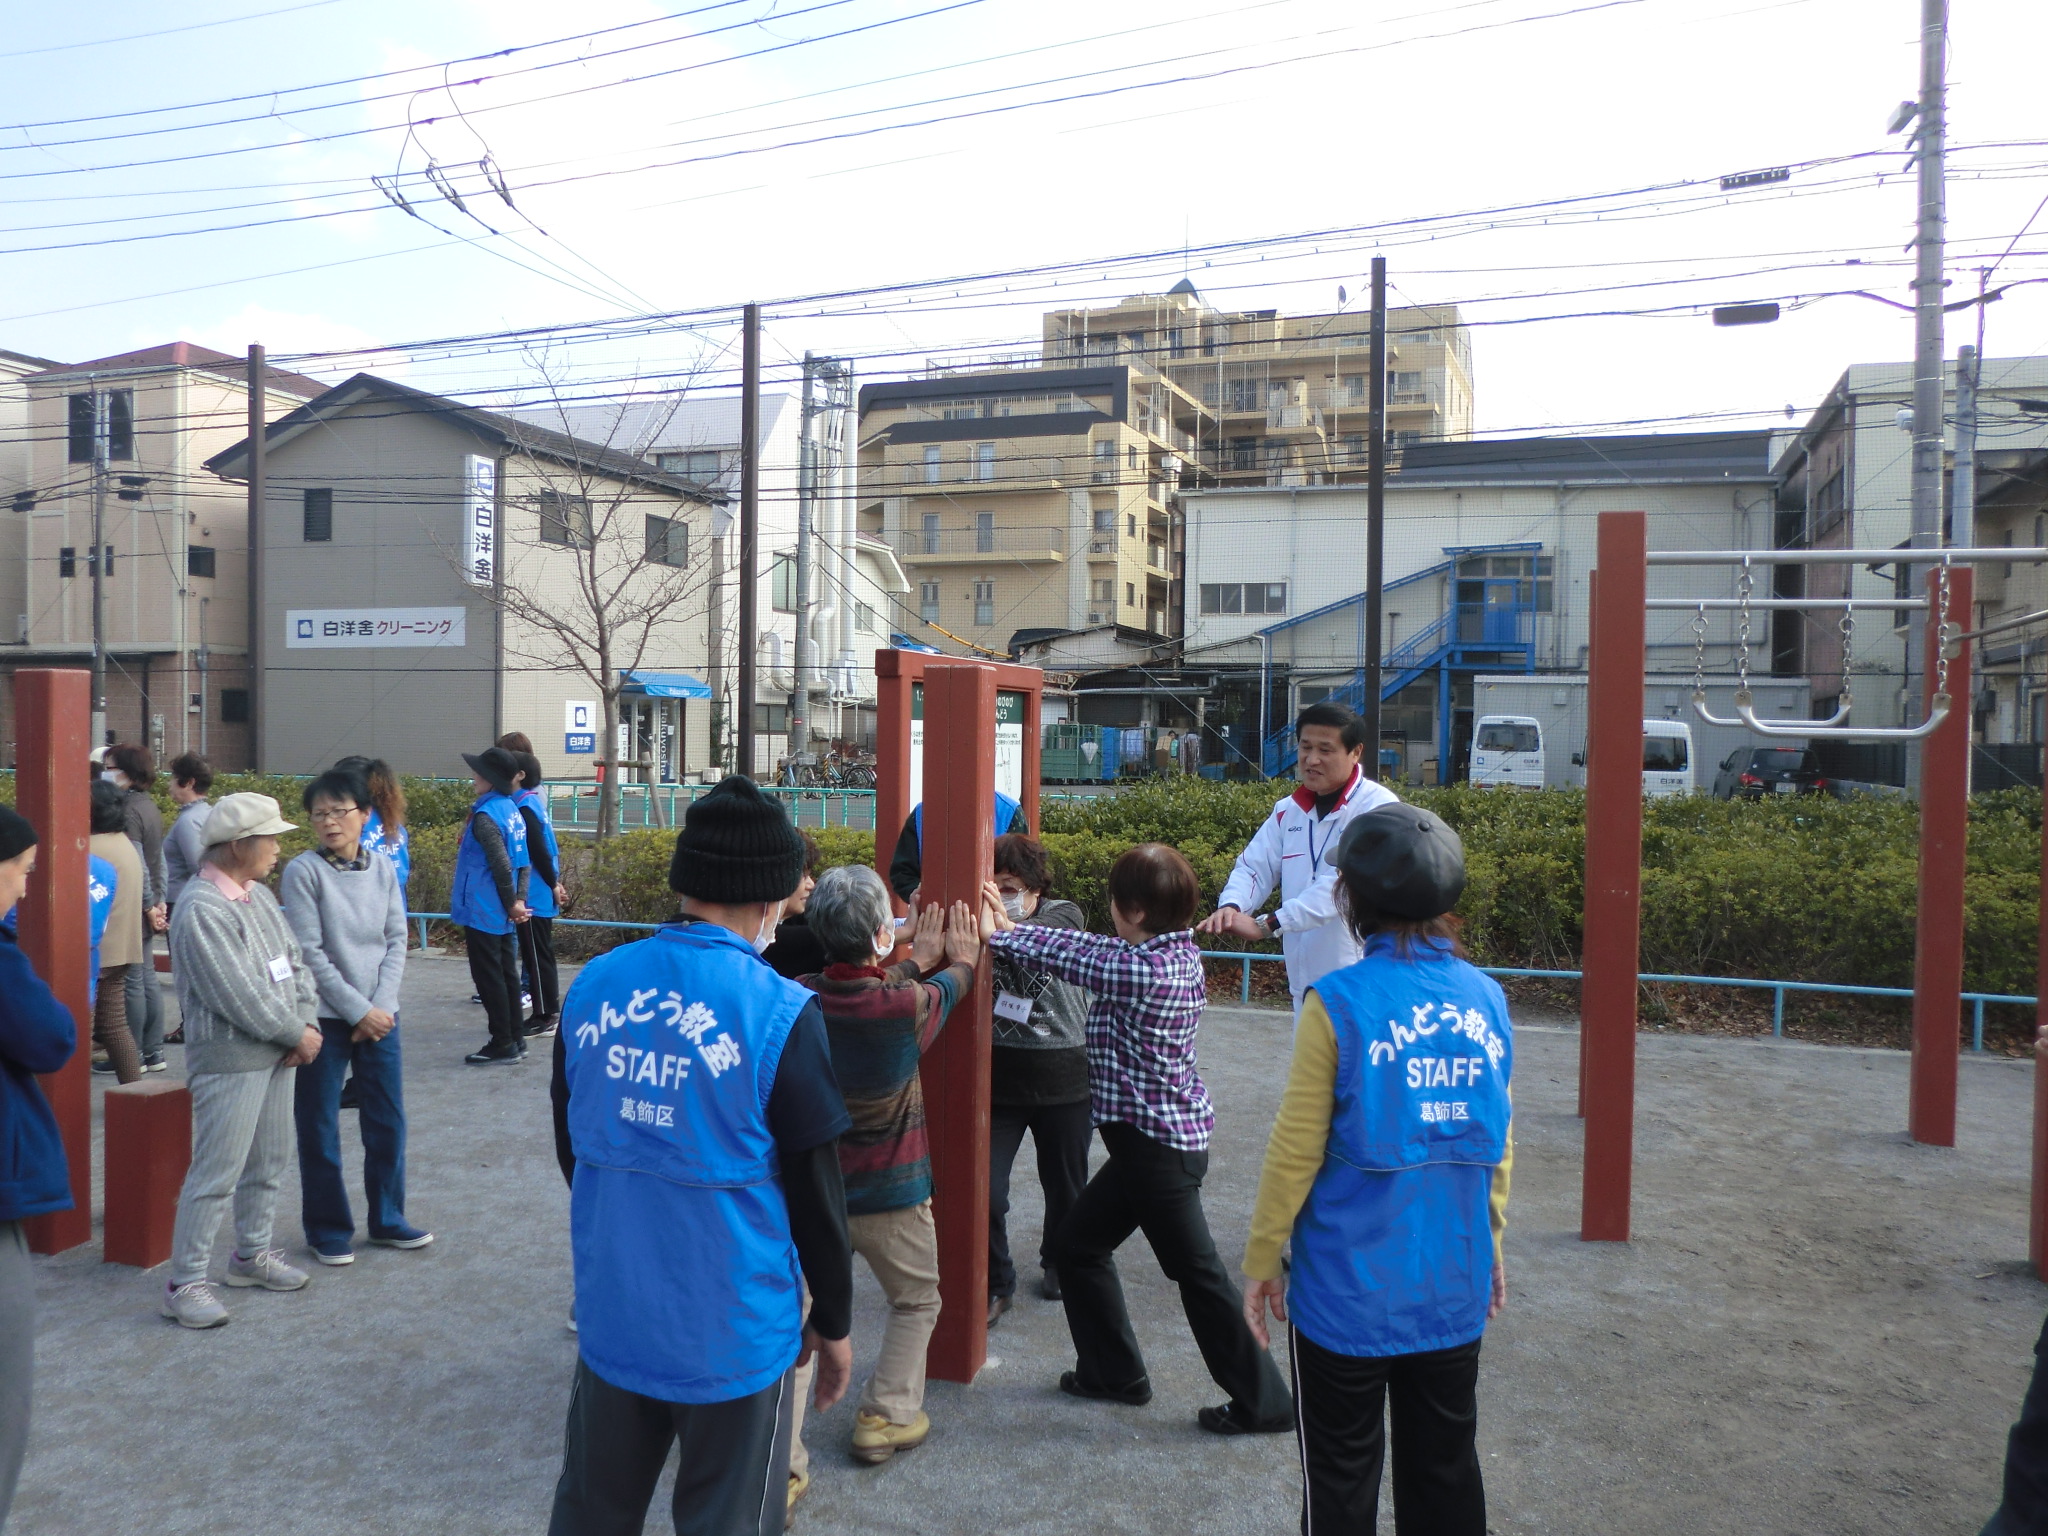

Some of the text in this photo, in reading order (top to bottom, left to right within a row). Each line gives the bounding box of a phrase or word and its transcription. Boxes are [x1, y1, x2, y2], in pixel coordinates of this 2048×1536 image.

[660, 706, 669, 776] Hakuyosha
[575, 987, 743, 1079] うんどう教室
[1369, 1002, 1505, 1070] うんどう教室
[606, 1044, 692, 1090] STAFF
[1406, 1057, 1483, 1088] STAFF
[619, 1096, 675, 1128] 葛飾区
[1420, 1101, 1470, 1122] 葛飾区
